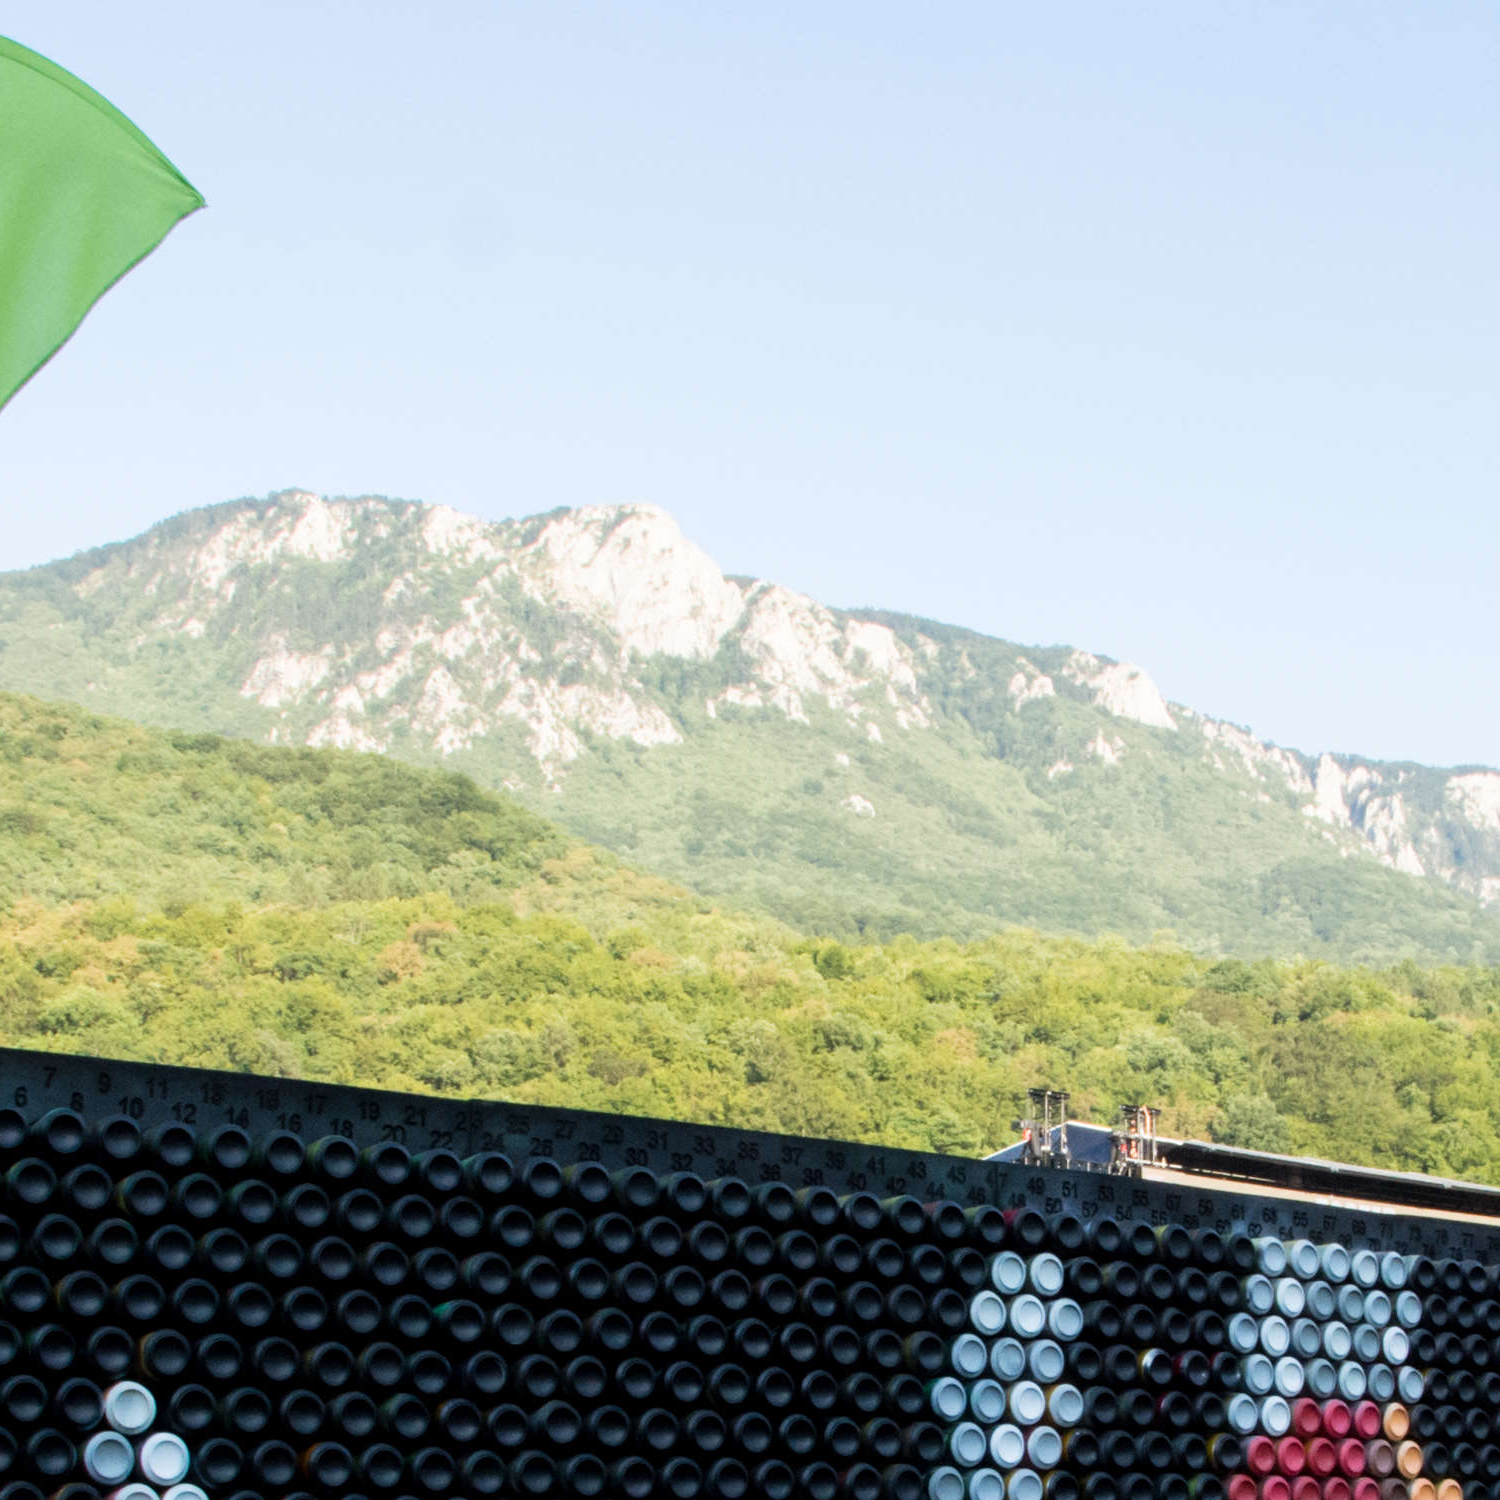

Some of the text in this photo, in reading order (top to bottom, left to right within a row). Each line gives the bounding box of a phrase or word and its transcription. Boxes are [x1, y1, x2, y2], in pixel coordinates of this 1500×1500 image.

[14, 1086, 27, 1107] 6
[71, 1092, 84, 1112] 8
[119, 1097, 144, 1119] 10
[171, 1102, 197, 1124] 12
[224, 1107, 249, 1126] 14
[278, 1112, 302, 1133] 16
[330, 1118, 353, 1137] 18
[381, 1124, 406, 1145] 20
[430, 1131, 452, 1150] 22
[482, 1132, 502, 1150] 24
[531, 1138, 552, 1156] 26
[578, 1142, 600, 1161] 28
[626, 1149, 648, 1166] 30
[671, 1154, 692, 1171] 32
[716, 1158, 736, 1176] 34
[761, 1163, 781, 1181] 36
[803, 1168, 823, 1186] 38
[847, 1173, 867, 1190] 40
[886, 1177, 906, 1195] 42
[926, 1182, 945, 1199] 44
[967, 1187, 986, 1204] 46
[1011, 1192, 1026, 1207] 48
[1046, 1197, 1062, 1213] 50
[1082, 1201, 1098, 1217] 52
[1115, 1205, 1132, 1220] 54
[1151, 1209, 1167, 1225] 56
[1183, 1213, 1199, 1228] 58
[1216, 1218, 1230, 1233] 60
[43, 1067, 57, 1088] 7
[98, 1073, 112, 1093] 9
[145, 1077, 168, 1099] 11
[202, 1082, 224, 1105] 13
[256, 1089, 280, 1112] 15
[304, 1095, 326, 1115] 17
[357, 1101, 381, 1121] 19
[404, 1105, 426, 1126] 21
[455, 1111, 483, 1131] 23
[505, 1114, 530, 1134] 25
[554, 1119, 578, 1139] 27
[602, 1126, 625, 1145] 29
[647, 1131, 668, 1150] 31
[693, 1136, 715, 1155] 33
[738, 1141, 759, 1160] 35
[782, 1147, 803, 1165] 37
[826, 1151, 845, 1170] 39
[867, 1156, 885, 1175] 41
[907, 1161, 926, 1179] 43
[947, 1166, 966, 1183] 45
[985, 1169, 1008, 1188] 47
[1027, 1177, 1045, 1195] 49
[1062, 1181, 1076, 1197] 51
[1099, 1185, 1114, 1202] 53
[1132, 1189, 1149, 1207] 55
[1166, 1194, 1182, 1211] 57
[1198, 1199, 1213, 1216] 59
[1231, 1204, 1245, 1220] 61
